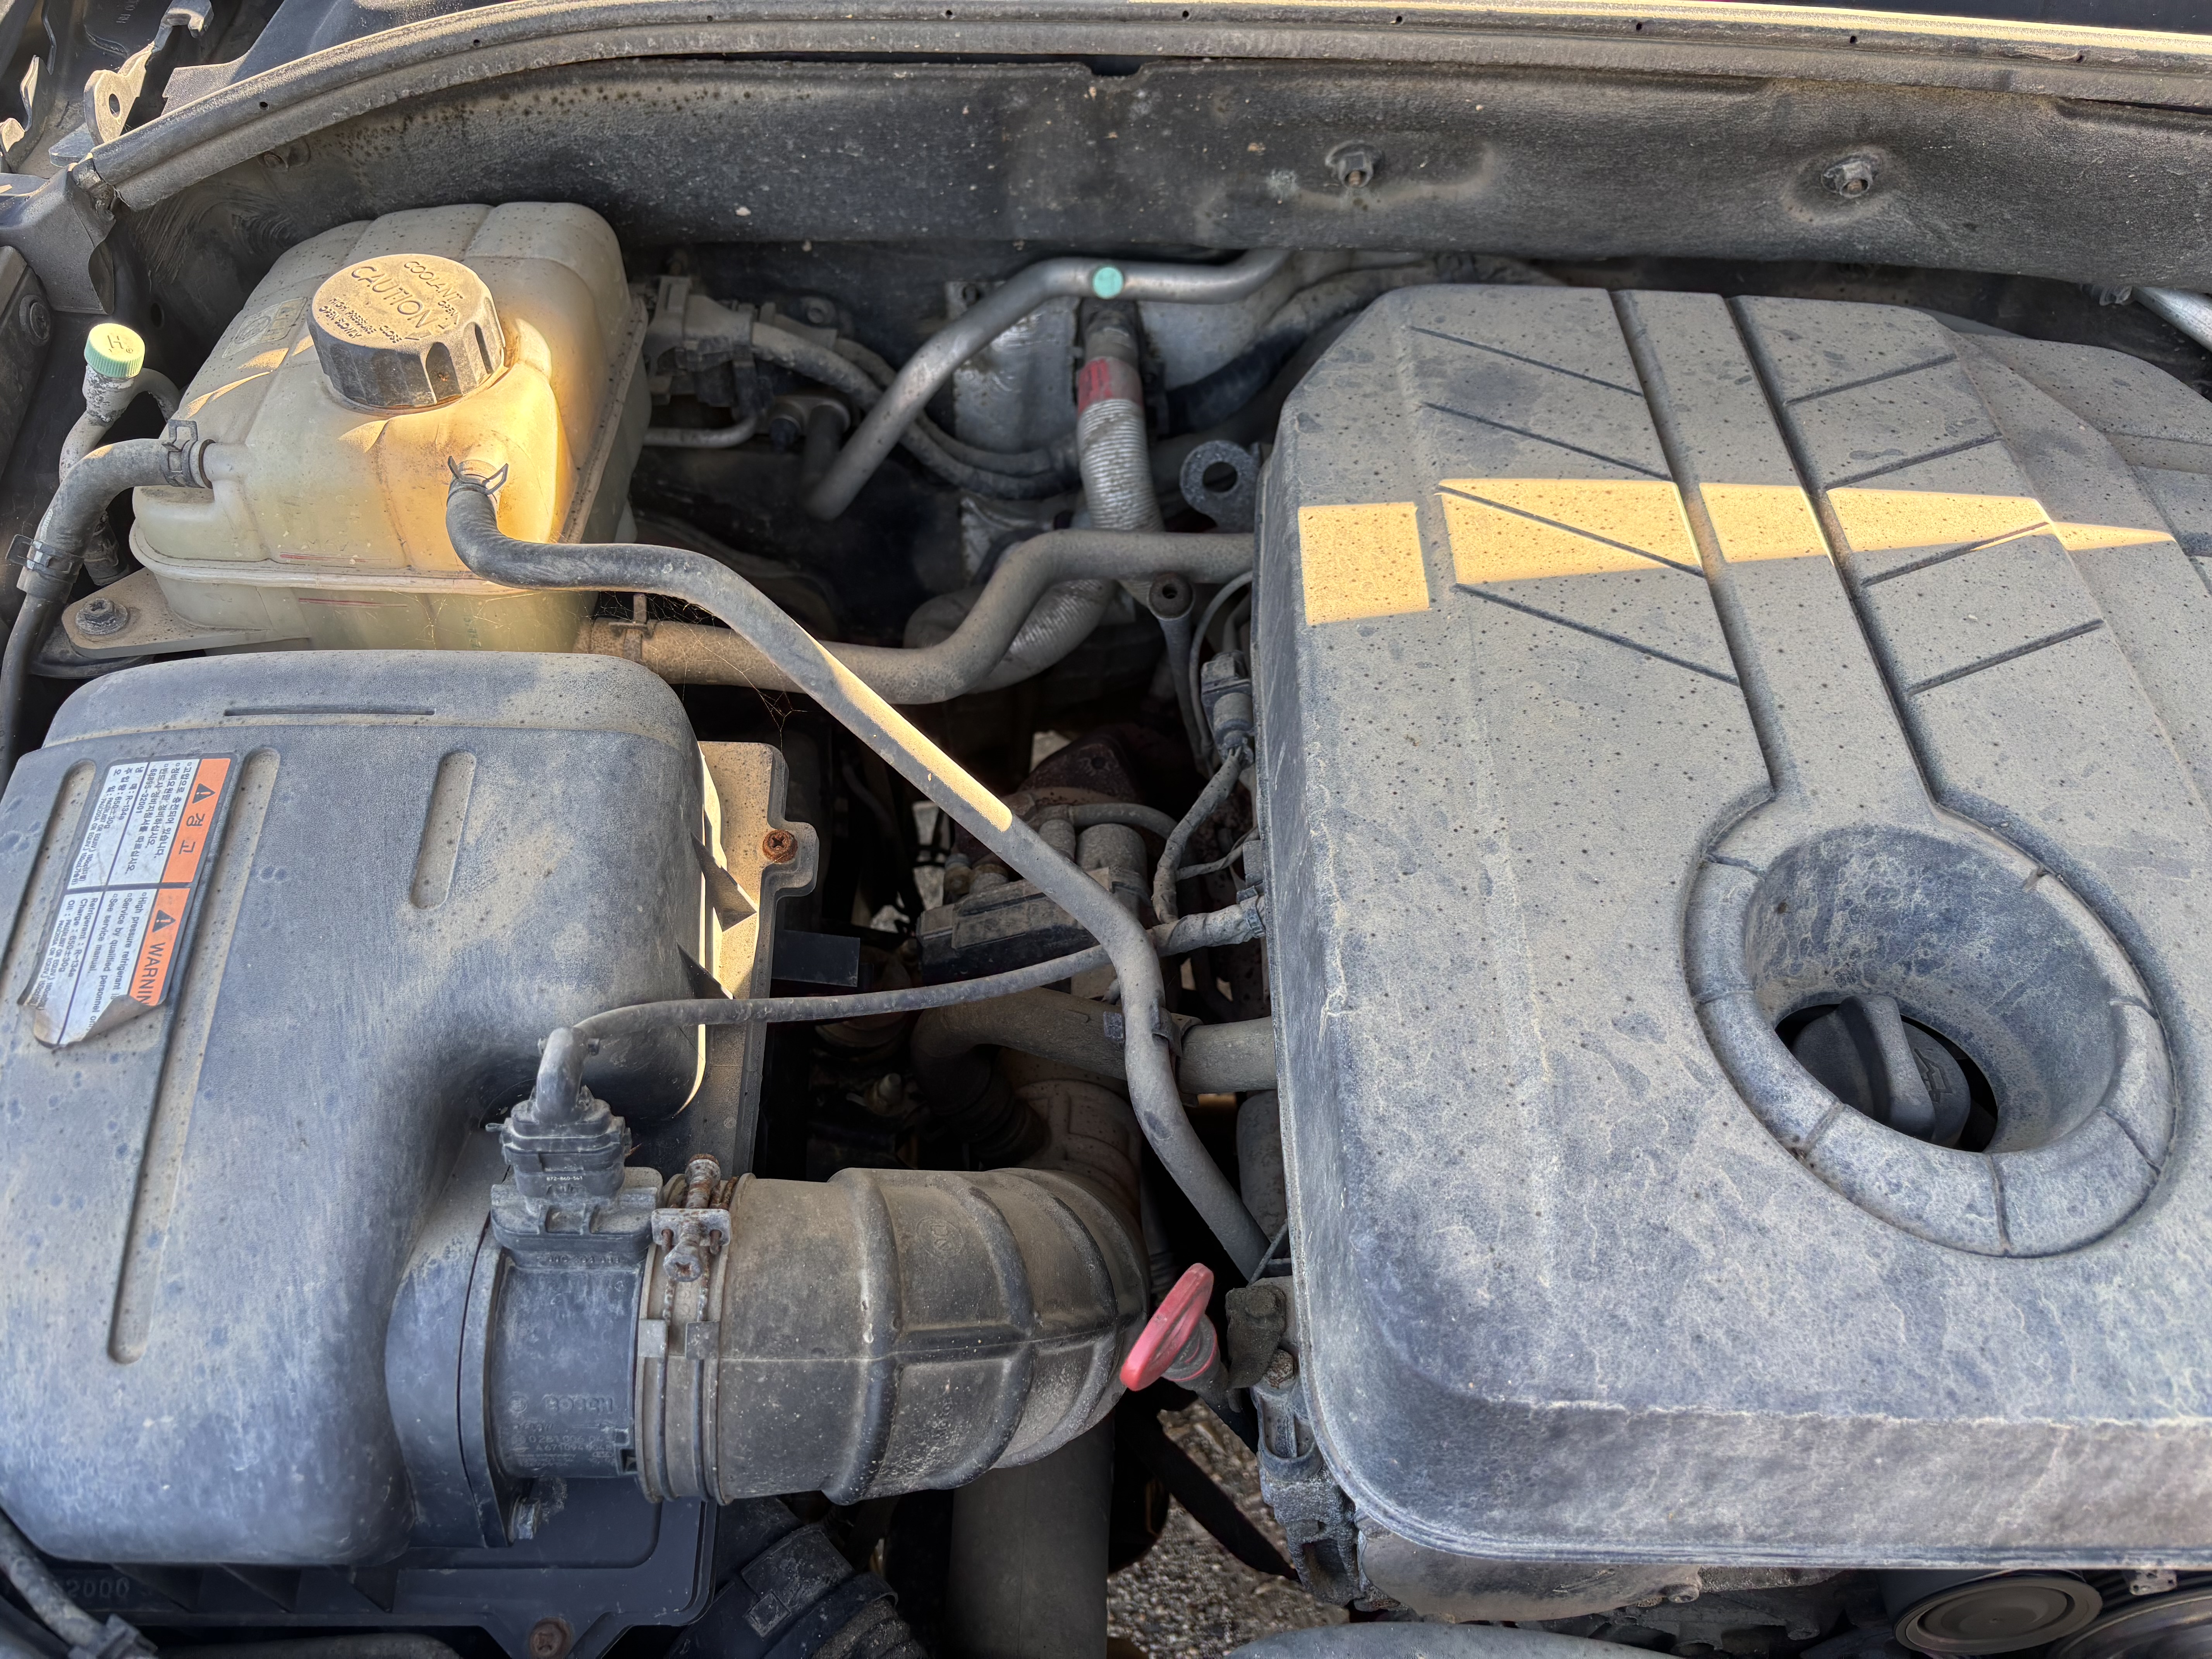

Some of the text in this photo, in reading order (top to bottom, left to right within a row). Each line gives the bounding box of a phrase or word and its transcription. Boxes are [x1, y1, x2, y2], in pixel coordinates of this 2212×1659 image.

[404, 261, 463, 301] COOLANT
[329, 297, 349, 311] HIGH
[351, 266, 438, 328] CAUTION
[438, 301, 458, 316] OPEN
[319, 306, 362, 338] OPEN SLOWLY
[379, 325, 402, 343] CLOSE
[107, 335, 124, 349] H
[154, 768, 169, 788] 반드시
[103, 796, 122, 829] 650±30g
[118, 795, 133, 820] R-134a
[145, 767, 180, 848] 정비요원만 정비하십시오.
[153, 766, 192, 858] 고압으로 충전되어 있습니다.
[125, 836, 146, 874] 따르십시오.
[65, 900, 76, 910] Oil
[72, 898, 89, 926] Charge
[78, 898, 98, 939] Refrigerant
[116, 897, 133, 924] Service
[133, 896, 148, 913] High
[87, 898, 118, 974] See service manual.
[112, 927, 124, 936] by
[122, 917, 140, 948] pressure
[48, 948, 56, 956] OR
[54, 949, 63, 957] OR
[58, 936, 77, 972] 650±30g
[67, 949, 82, 977] R-134a
[102, 939, 120, 972] qualified
[110, 951, 131, 990] refrigerant
[136, 942, 166, 1005] WARNIN
[92, 975, 108, 1012] personnel
[543, 1395, 613, 1413] BOSCH
